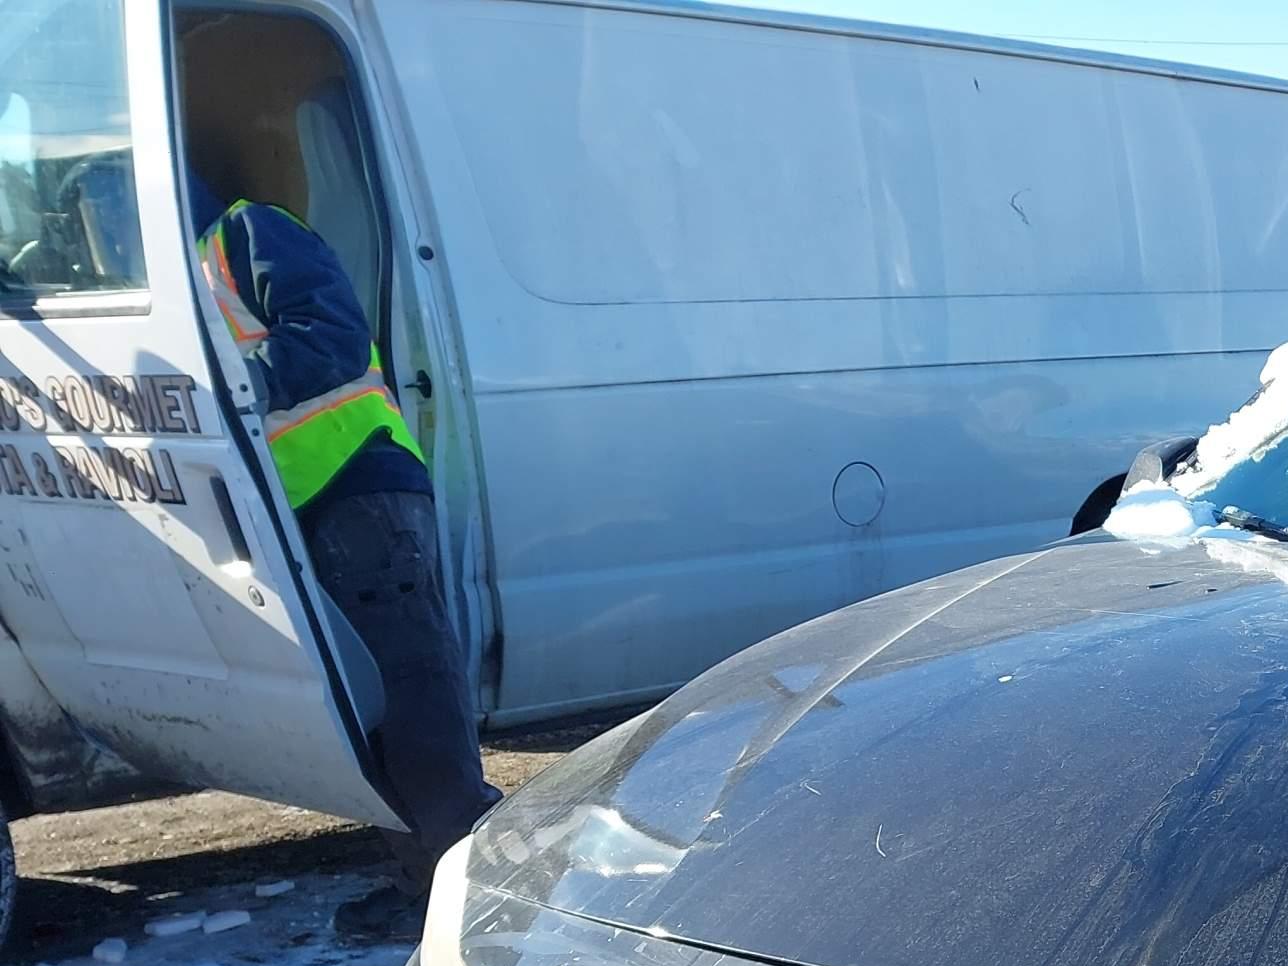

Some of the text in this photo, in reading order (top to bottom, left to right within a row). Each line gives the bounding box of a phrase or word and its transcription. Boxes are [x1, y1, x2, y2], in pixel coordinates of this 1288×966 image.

[45, 374, 202, 434] GOURMET
[31, 452, 64, 498] &
[53, 445, 187, 506] RAVIOLI
